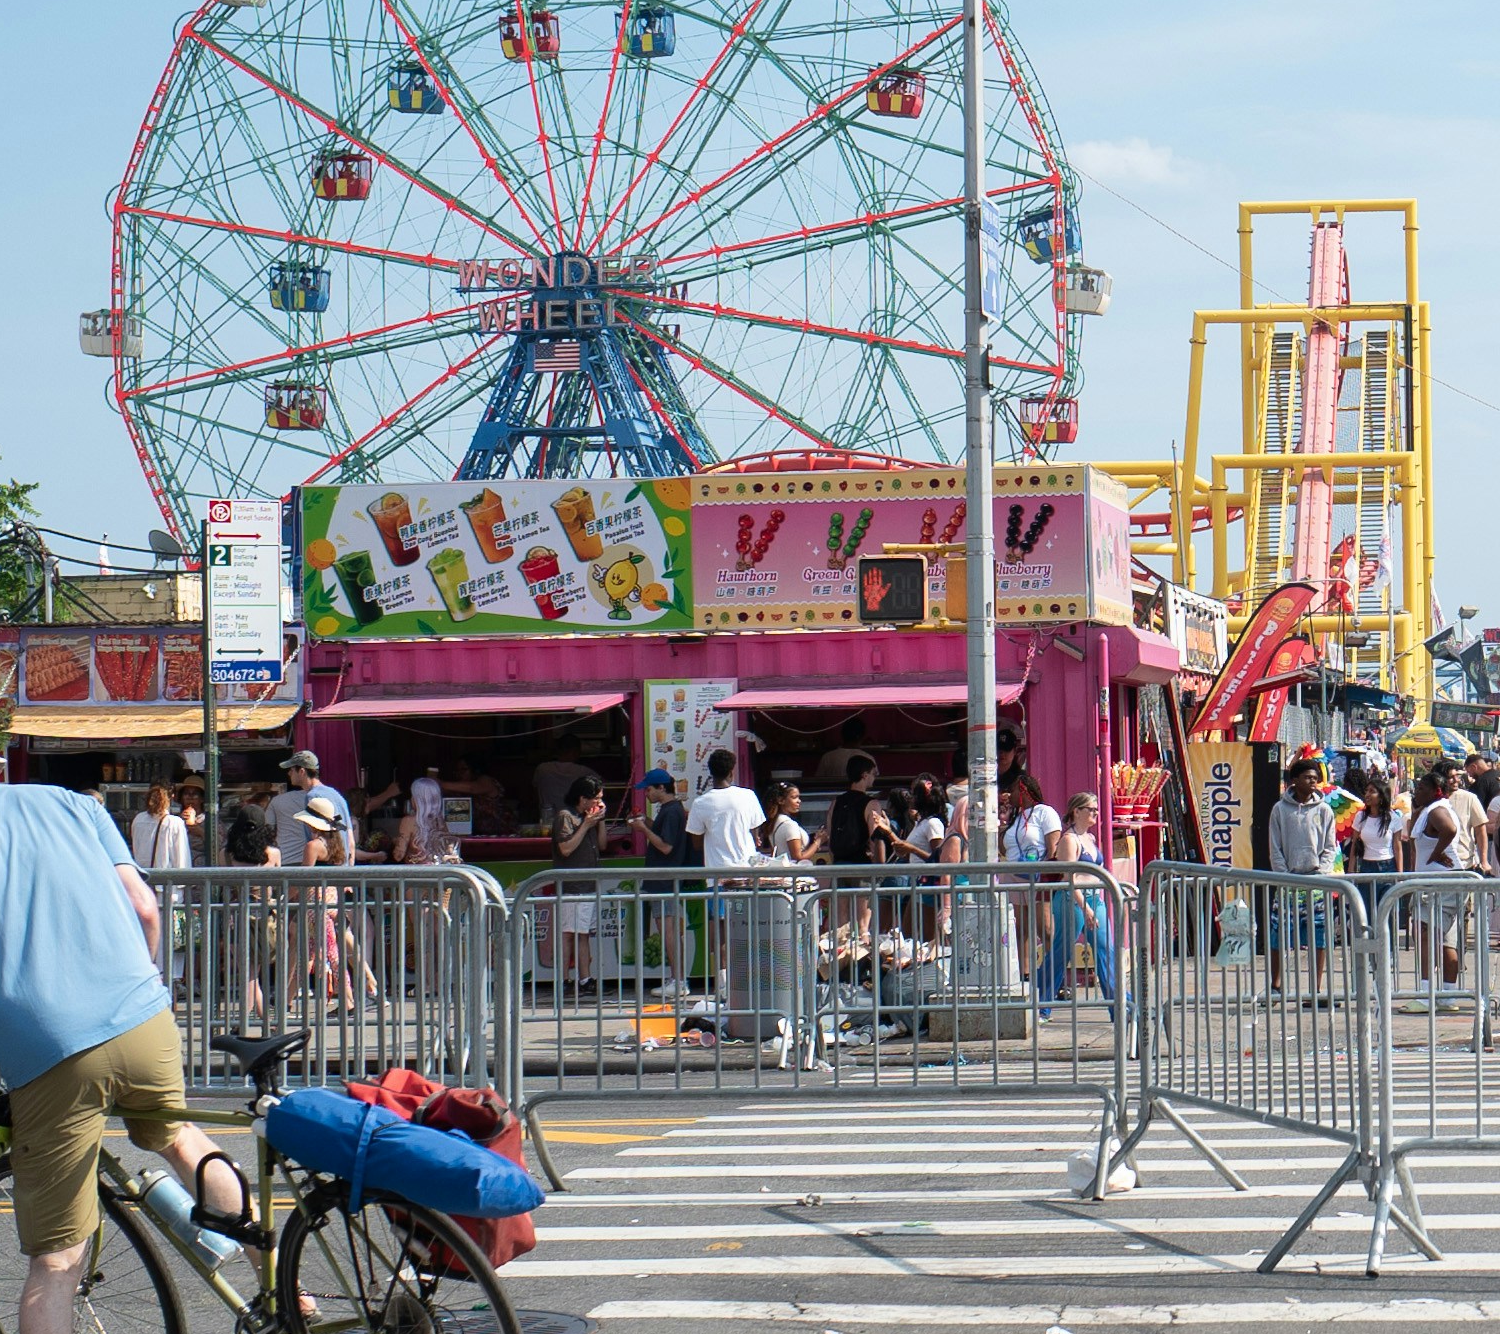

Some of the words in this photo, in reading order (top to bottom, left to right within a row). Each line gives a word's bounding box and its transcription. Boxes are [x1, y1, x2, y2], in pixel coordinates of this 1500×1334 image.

[586, 505, 643, 536] 百香果柠檬茶
[427, 537, 448, 549] Lemon
[448, 532, 460, 543] Tea
[496, 537, 518, 549] Mango
[517, 530, 540, 542] Lemon
[539, 525, 551, 536] Tea
[604, 527, 629, 540] Passion
[612, 533, 634, 545] Lemon
[633, 529, 645, 539] Tea
[214, 546, 227, 565] 2
[717, 569, 778, 583] Hawthorn
[803, 568, 840, 581] Green
[392, 589, 413, 601] Lemon
[471, 591, 490, 603] Green
[490, 584, 510, 598] Grape
[477, 596, 499, 608] Lemon
[498, 591, 511, 602] Tea
[554, 597, 576, 609] Lemon
[575, 593, 587, 603] Tea
[385, 600, 404, 611] Green
[404, 596, 416, 605] Tea
[212, 669, 256, 681] 304672
[1397, 747, 1439, 755] SABRETT
[1201, 791, 1210, 839] NATURAL
[1204, 762, 1241, 867] napple
